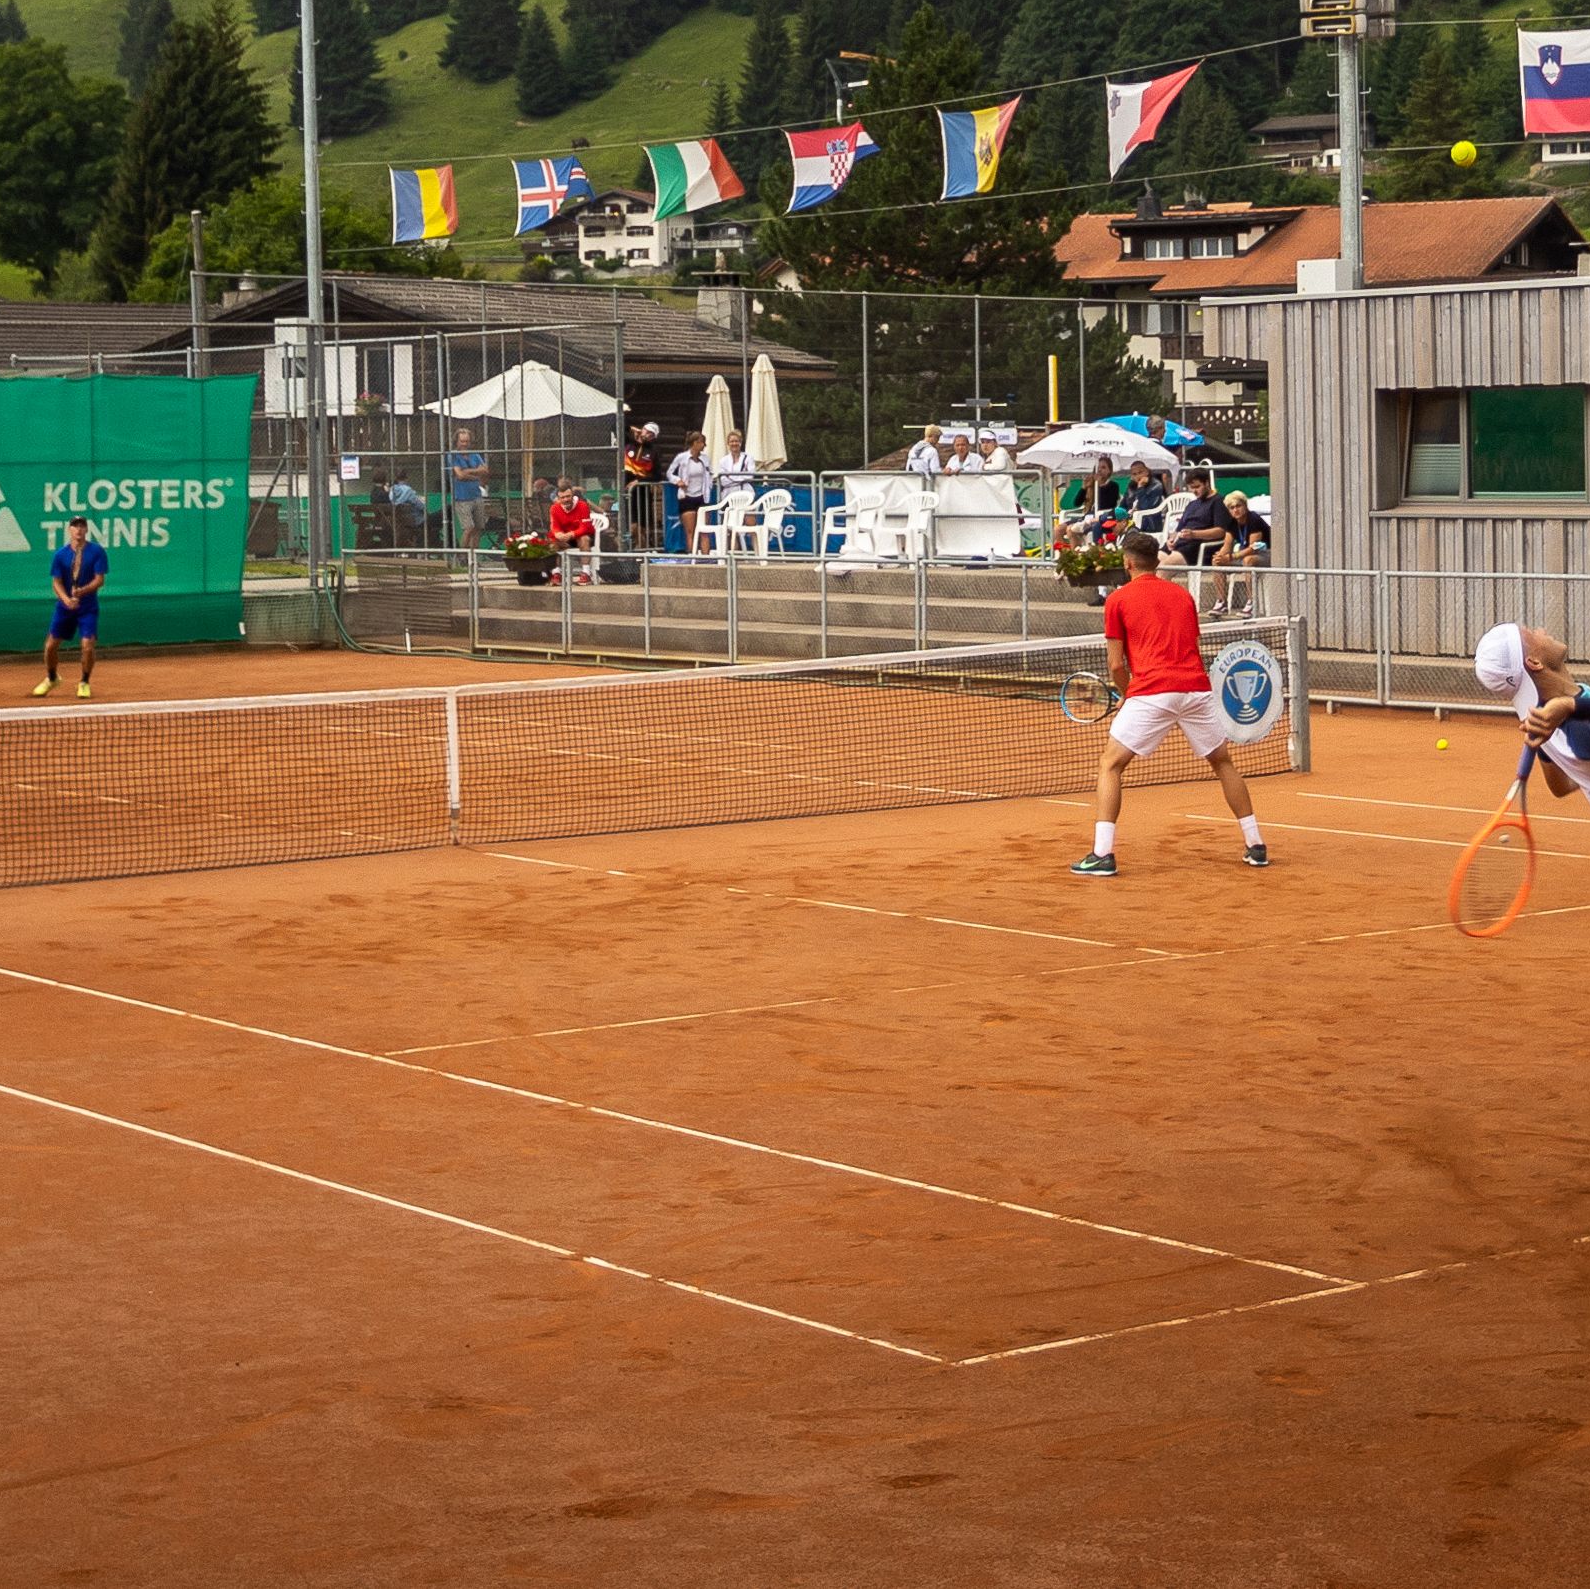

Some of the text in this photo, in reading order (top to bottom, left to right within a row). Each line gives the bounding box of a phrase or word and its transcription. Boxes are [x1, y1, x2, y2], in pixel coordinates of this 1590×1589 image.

[44, 479, 226, 512] KLOSTERS
[41, 516, 171, 551] TNNIS
[1219, 647, 1272, 674] EUROPEAN
